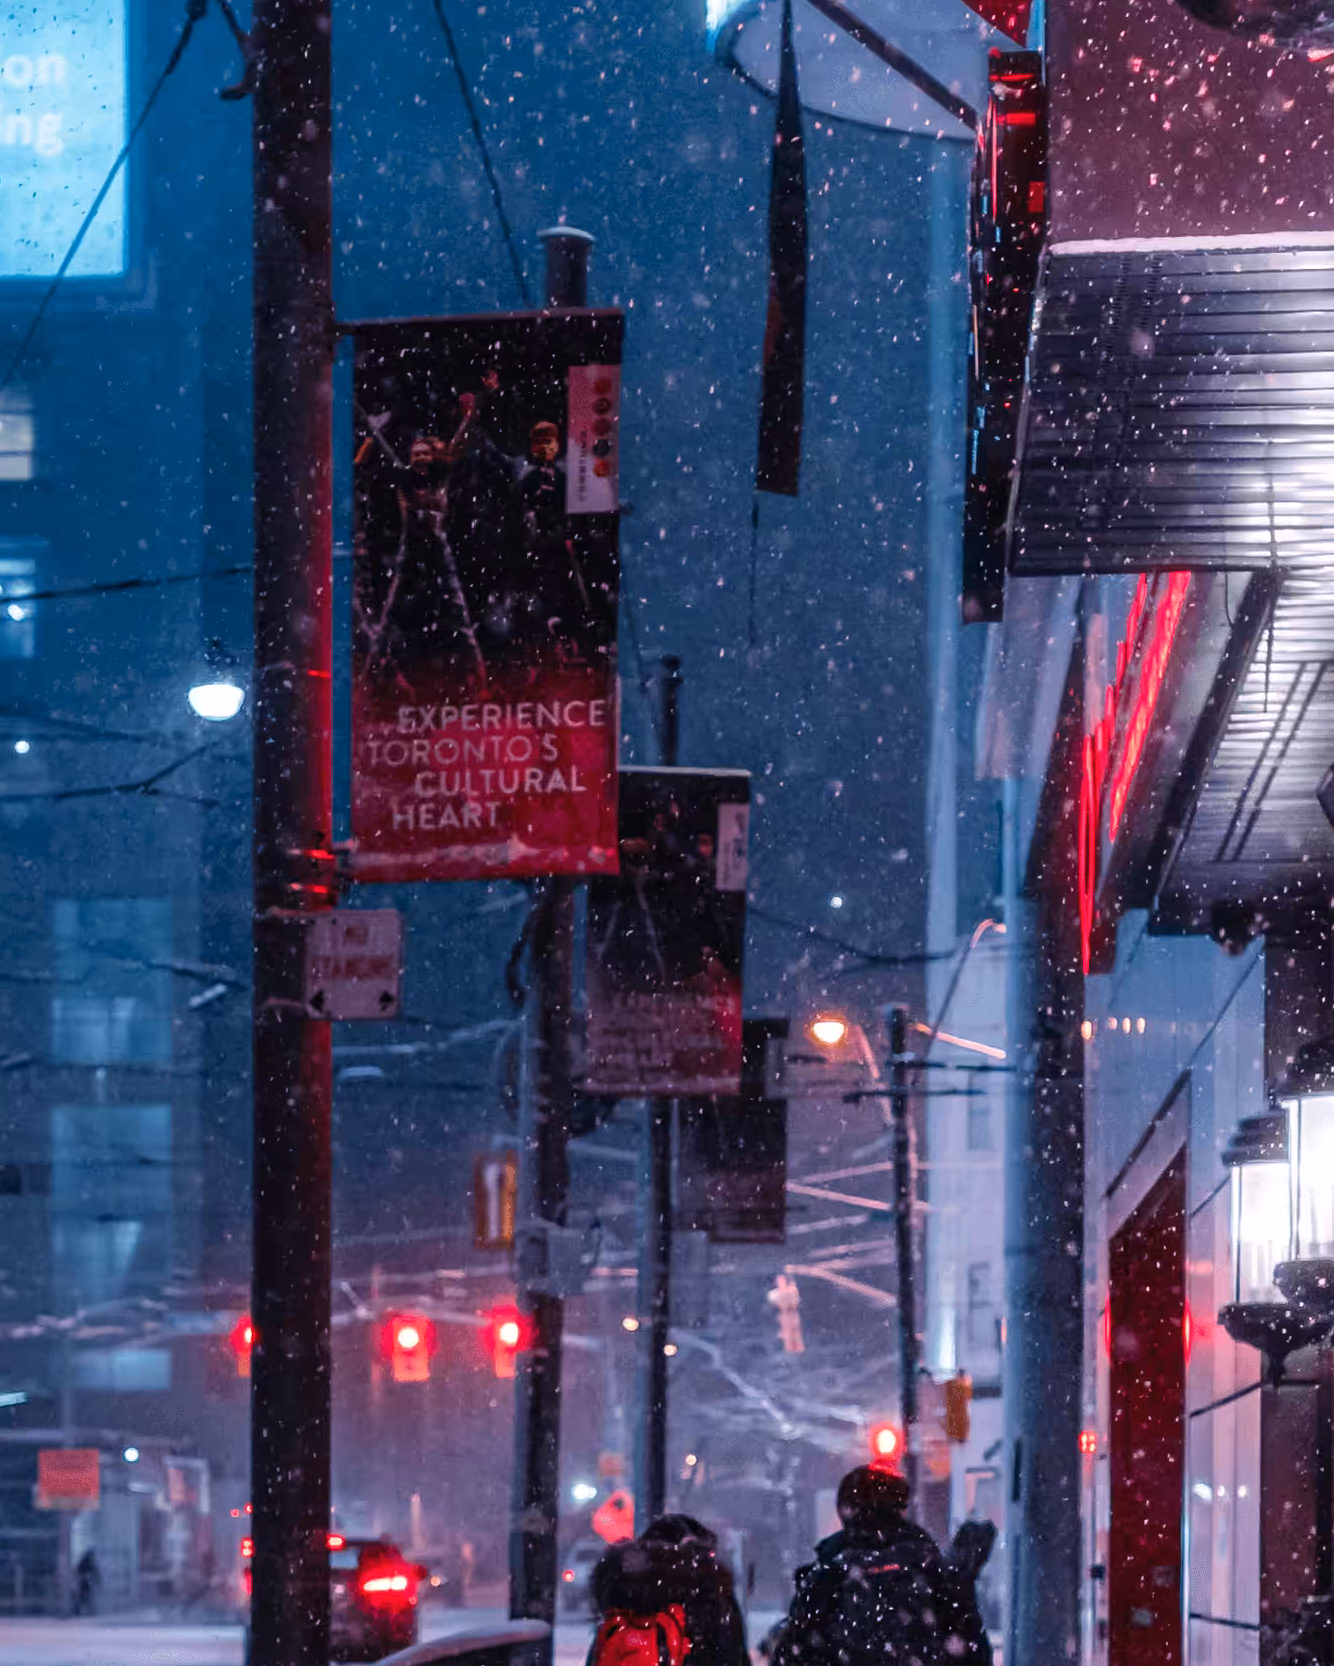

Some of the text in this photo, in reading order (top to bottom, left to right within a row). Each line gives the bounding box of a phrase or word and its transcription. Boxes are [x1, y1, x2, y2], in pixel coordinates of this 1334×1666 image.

[395, 699, 607, 733] EXPERIENCE
[366, 732, 559, 767] TORONTO'S
[414, 764, 588, 798] CULTURAL
[391, 801, 501, 831] HEART
